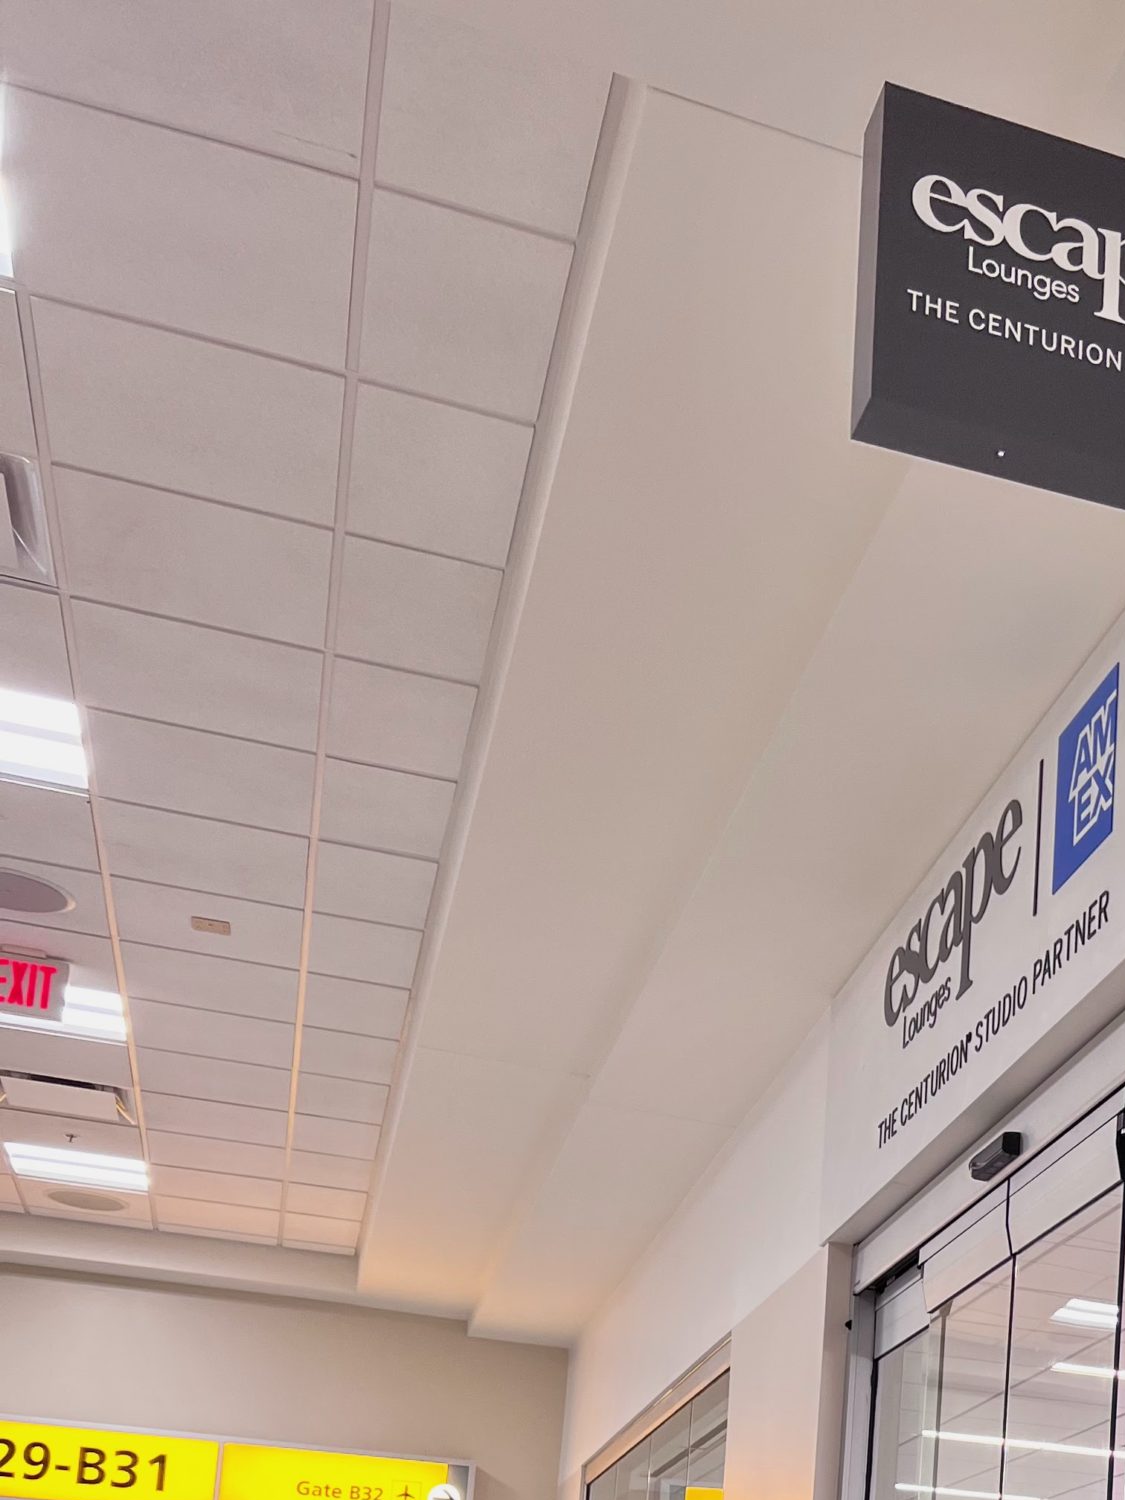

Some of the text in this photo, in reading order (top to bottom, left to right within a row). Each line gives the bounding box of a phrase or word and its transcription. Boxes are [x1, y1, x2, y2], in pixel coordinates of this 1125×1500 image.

[968, 246, 1080, 304] Lounges
[907, 288, 959, 324] THE
[968, 308, 1123, 371] CENTURION
[883, 799, 1024, 1027] escape
[878, 1107, 898, 1149] THE
[975, 976, 1028, 1052] STUDIO
[1032, 890, 1110, 995] PARTNER
[902, 977, 951, 1049] Lounges
[296, 1480, 342, 1498] Gate
